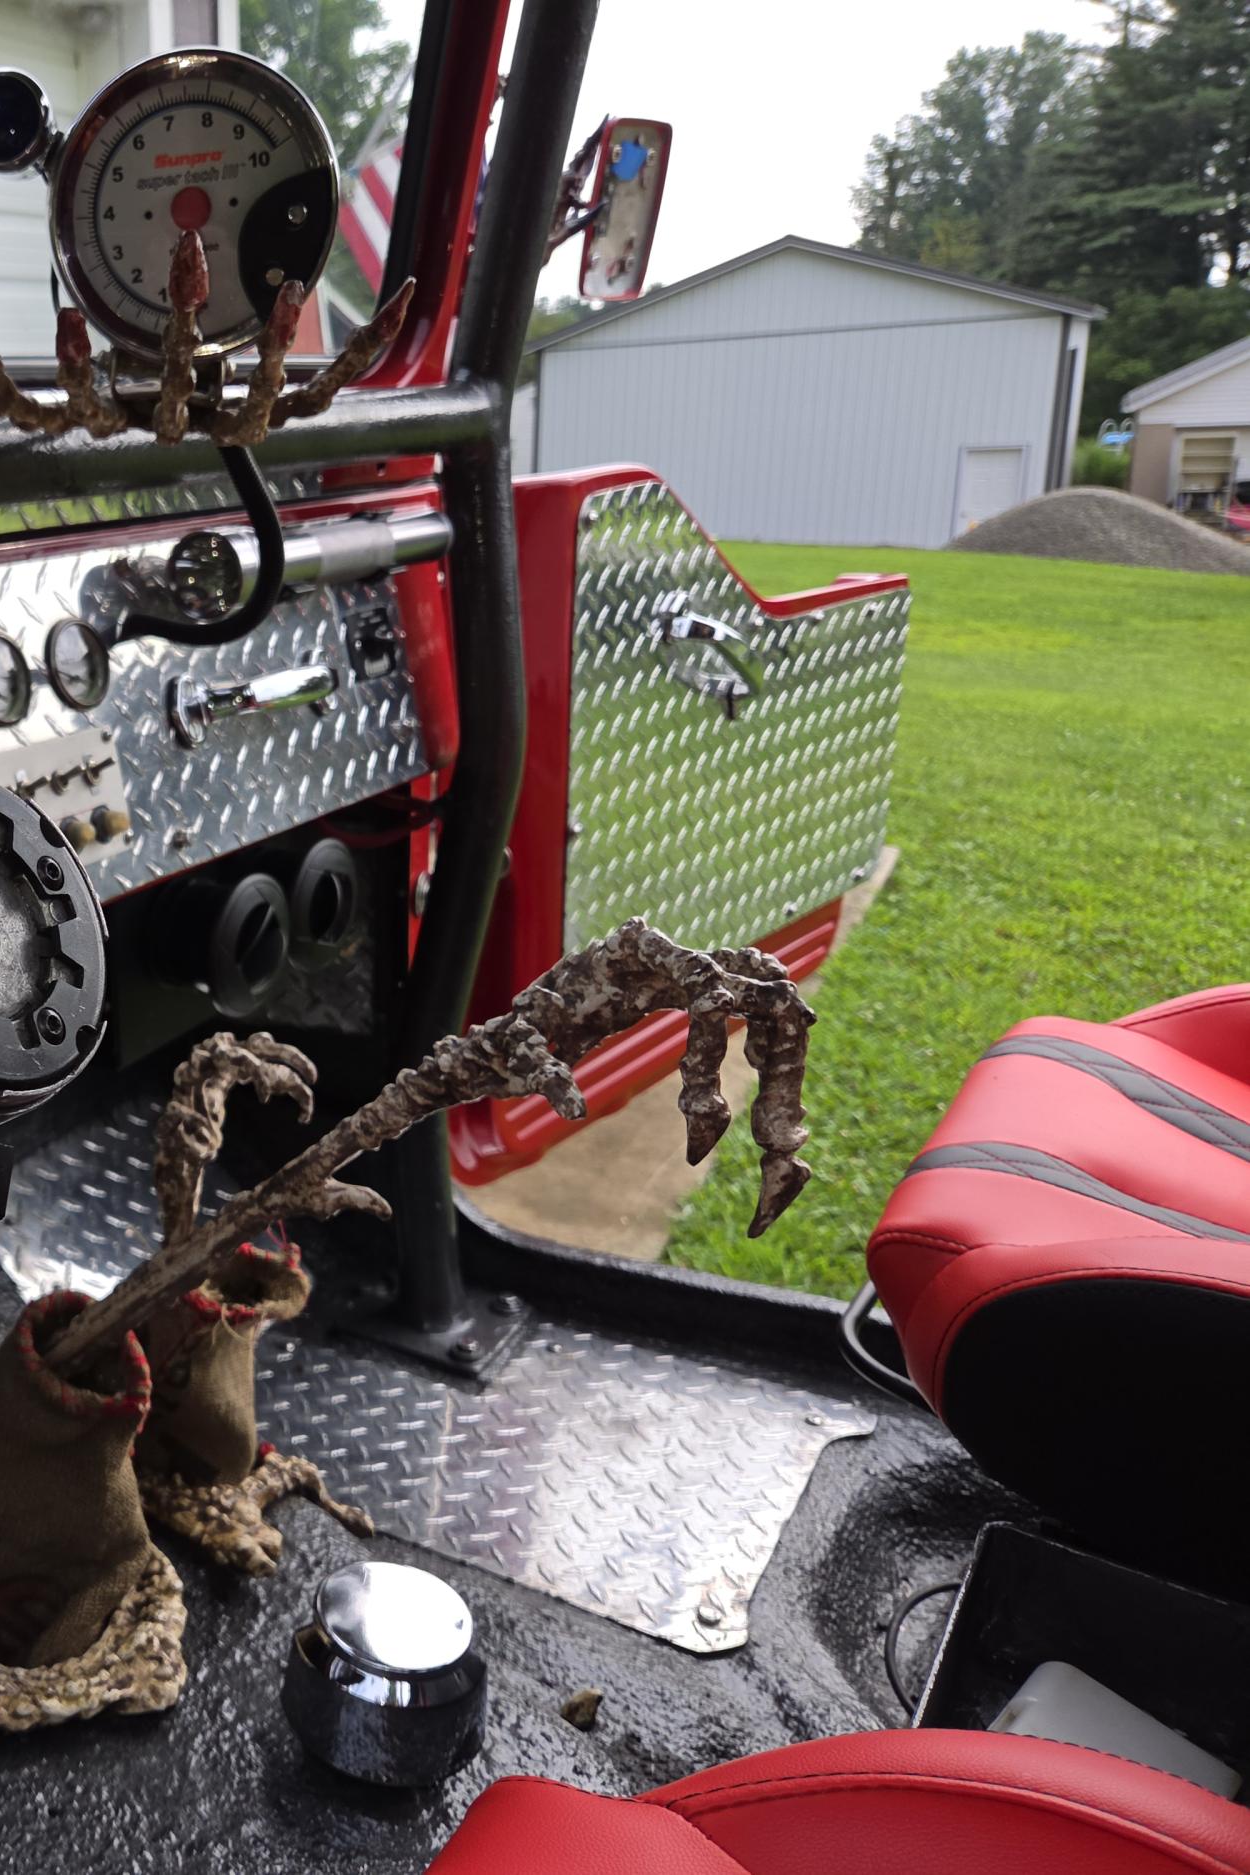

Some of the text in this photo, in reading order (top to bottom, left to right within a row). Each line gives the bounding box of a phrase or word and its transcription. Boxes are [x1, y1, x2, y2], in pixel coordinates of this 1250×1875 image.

[162, 116, 174, 132] 7
[201, 112, 213, 128] 8
[233, 124, 245, 140] 9
[133, 134, 146, 151] 6
[154, 151, 222, 169] Sunpro
[249, 151, 270, 168] 10
[112, 166, 124, 183] 5
[137, 174, 182, 191] super
[184, 167, 220, 183] tech
[103, 206, 116, 221] 4
[112, 245, 124, 261] 3
[131, 268, 143, 284] 2
[158, 288, 168, 303] 1
